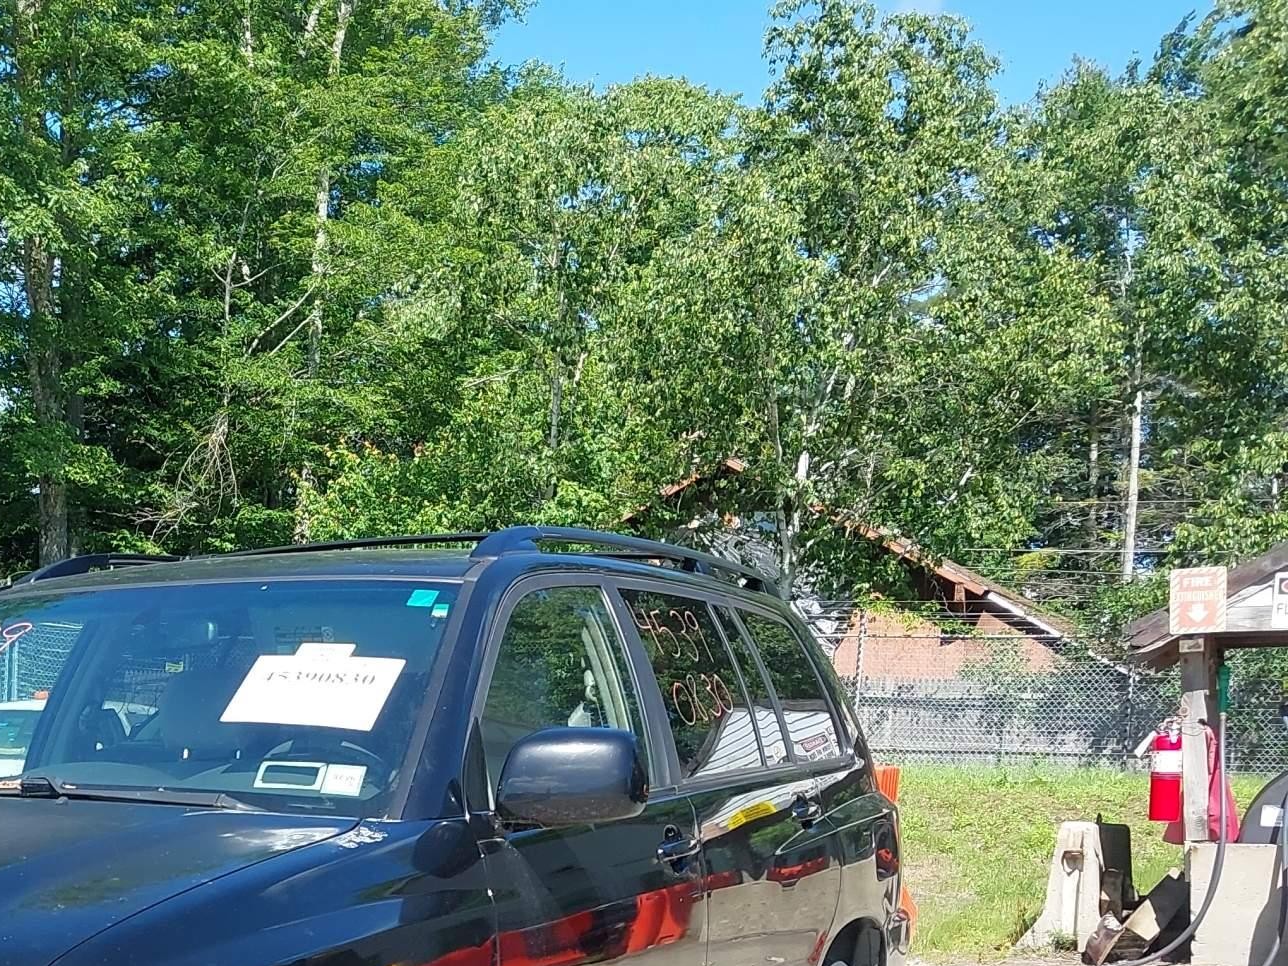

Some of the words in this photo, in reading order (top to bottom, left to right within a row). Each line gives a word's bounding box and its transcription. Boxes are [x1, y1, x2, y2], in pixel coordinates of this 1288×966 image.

[1182, 576, 1216, 588] FIRE
[624, 599, 714, 663] 4539
[673, 673, 733, 725] 0830
